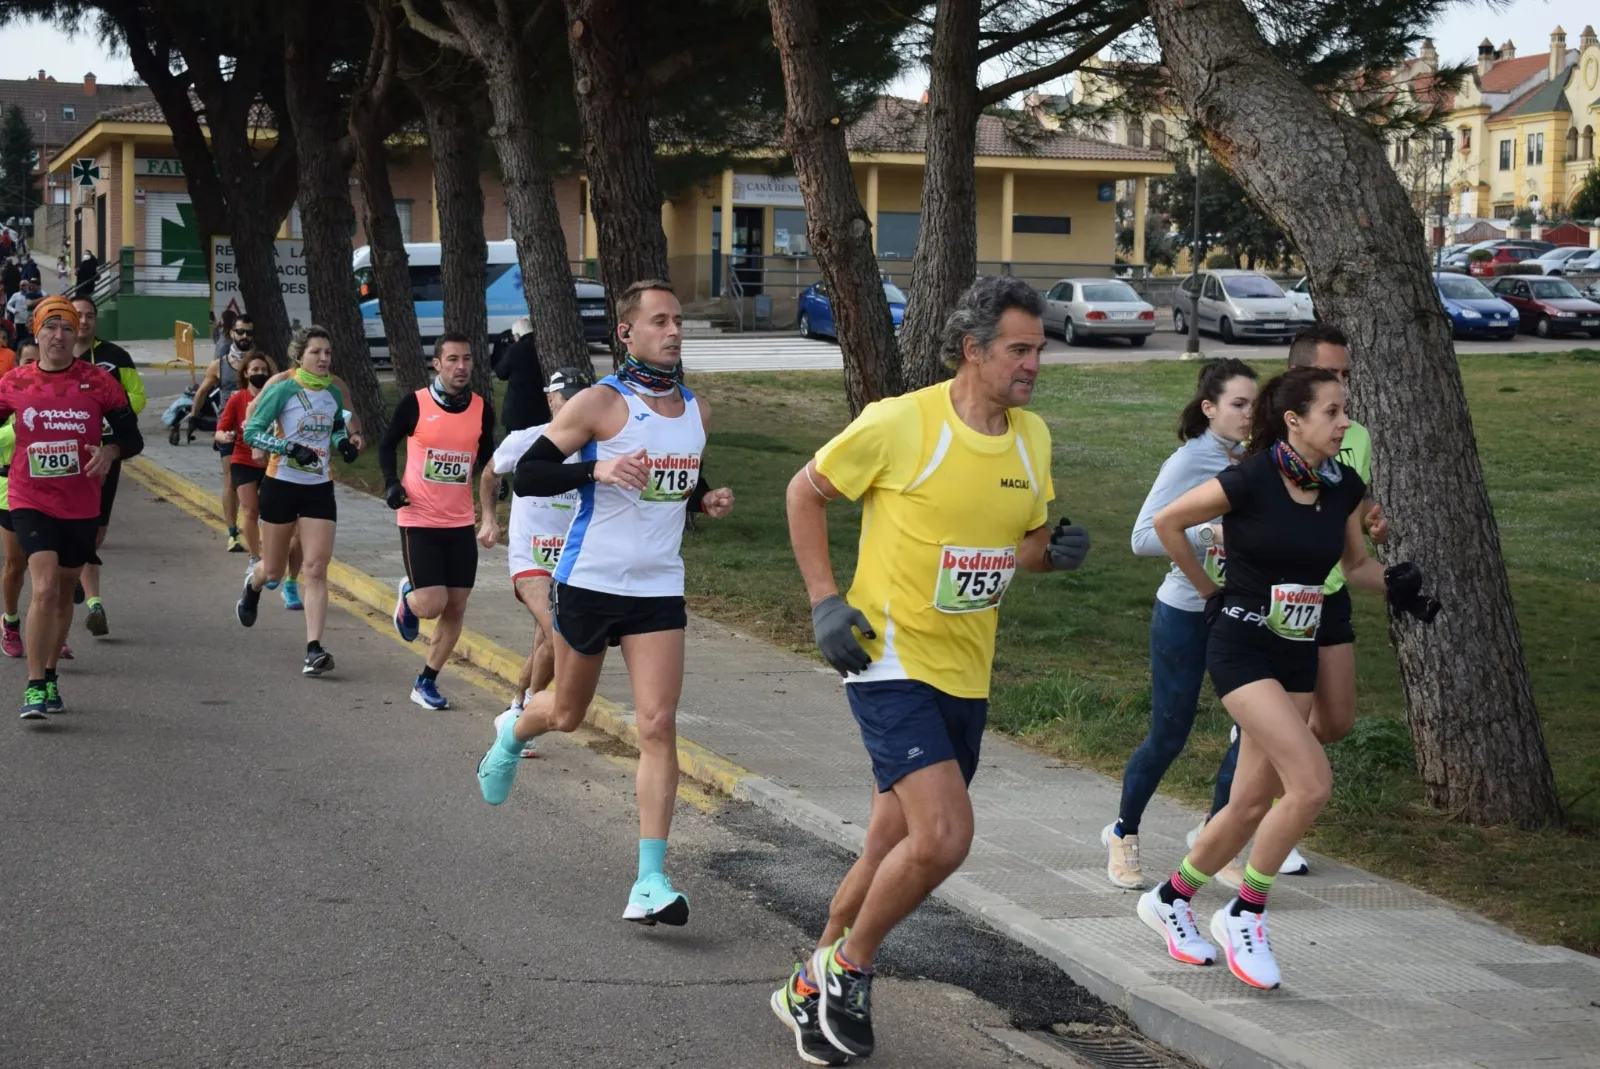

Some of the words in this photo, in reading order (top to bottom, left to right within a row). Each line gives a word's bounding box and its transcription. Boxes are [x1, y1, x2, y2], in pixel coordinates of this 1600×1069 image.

[39, 408, 90, 421] apaches
[43, 421, 86, 433] running
[38, 454, 69, 469] 780
[434, 461, 461, 475] 750
[643, 455, 699, 470] bedunia
[654, 470, 688, 491] 718
[1000, 478, 1030, 490] MACIAS
[541, 547, 561, 563] 75
[942, 551, 1015, 571] bedunia
[957, 571, 1002, 597] 753
[1281, 604, 1315, 627] 717
